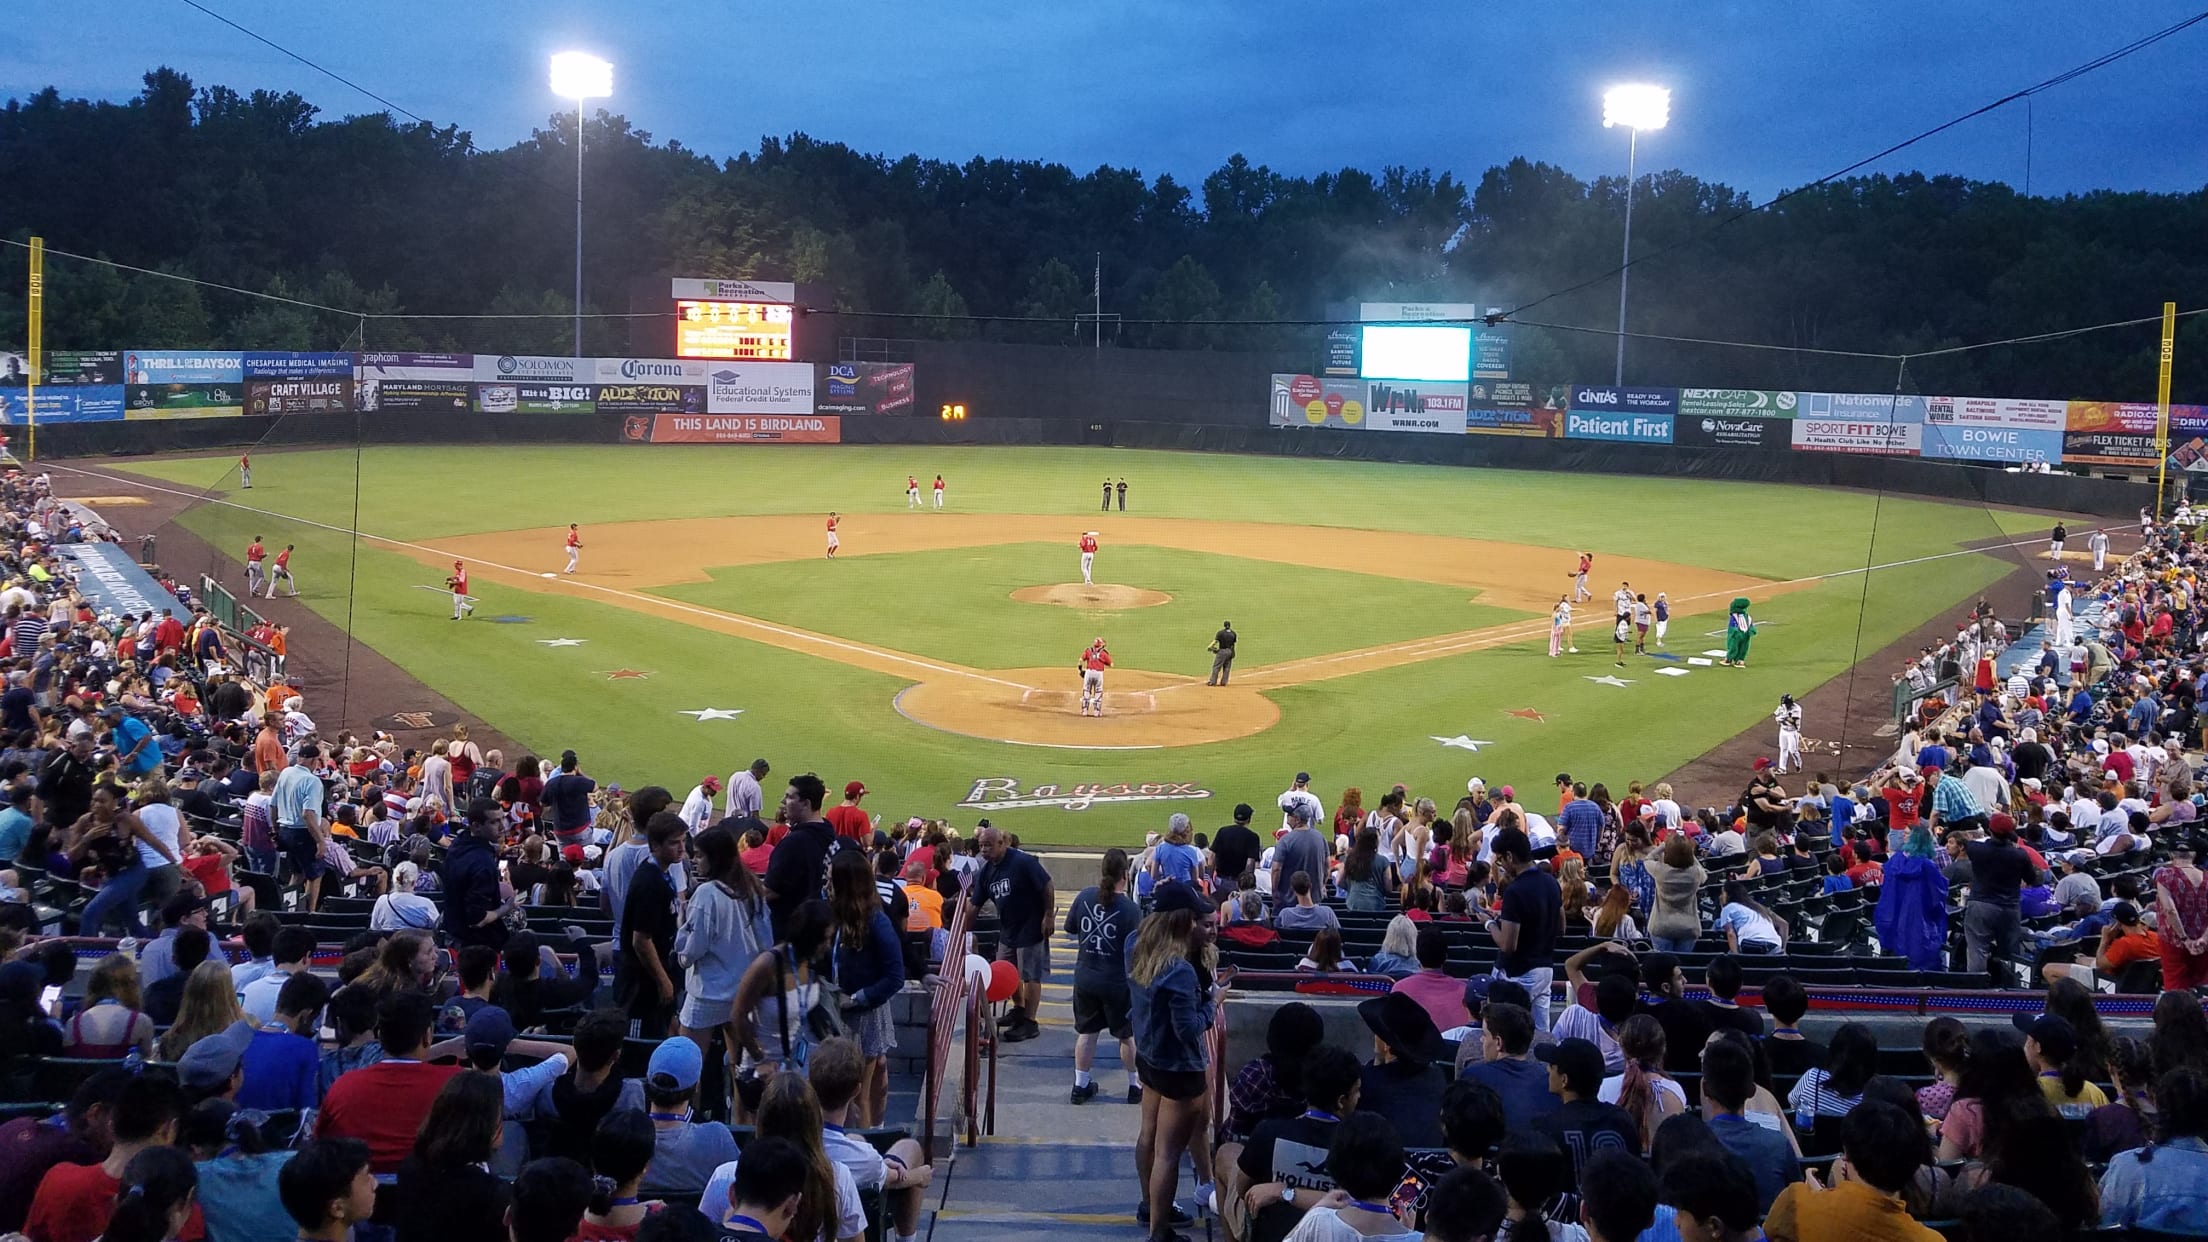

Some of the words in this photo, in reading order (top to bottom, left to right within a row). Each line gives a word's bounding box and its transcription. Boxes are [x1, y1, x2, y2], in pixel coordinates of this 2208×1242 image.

[718, 288, 765, 296] Recreation
[141, 358, 185, 369] THRILL
[194, 358, 241, 369] BAYSOX
[246, 359, 287, 367] CHESAPEAKE
[288, 359, 316, 367] MEDICAL
[318, 359, 349, 367] IMAGING
[362, 353, 400, 364] graphcom
[518, 360, 574, 370] SOLOMON
[621, 360, 683, 380] Corona
[254, 368, 277, 376] Radiology
[830, 366, 855, 376] DCA
[873, 366, 912, 383] TECHNOLOGY
[271, 383, 300, 396] CRAFT
[300, 383, 342, 395] VILLAGE
[521, 389, 537, 397] Hit
[540, 389, 548, 397] it
[548, 387, 591, 400] BIG!
[716, 386, 771, 395] Educational
[774, 386, 812, 397] Systems
[892, 384, 905, 392] FOR
[1683, 389, 1747, 400] NEXTCAR
[881, 396, 910, 410] BUSINESS
[1427, 398, 1448, 408] 103.1
[1449, 398, 1462, 409] FM
[1834, 395, 1913, 407] Nationwde
[818, 404, 867, 412] dcaimaging.com
[1834, 409, 1880, 418] Insurance
[1930, 404, 1954, 413] RENTAL
[1929, 413, 1954, 421] WORKS
[673, 418, 701, 430] THIS
[706, 418, 742, 430] LAND
[745, 418, 757, 430] IS
[760, 418, 826, 431] BIRDLAND.
[1392, 419, 1439, 428] WRNR.COM
[1569, 415, 1629, 435] Patient
[1633, 417, 1669, 437] First
[1715, 420, 1764, 432] NovaCare
[1806, 422, 1846, 434] SPORT
[1847, 424, 1875, 435] FIT
[1876, 425, 1907, 436] BOWIE
[1963, 430, 2019, 444] BOWIE
[2092, 435, 2112, 445] FLEX
[2114, 436, 2144, 446] TICKET
[1936, 444, 1981, 456] TOWN
[1986, 447, 2046, 460] CENTER
[964, 778, 1212, 811] Baysox
[1093, 903, 1105, 921] G
[1103, 923, 1117, 939] C
[1275, 1171, 1339, 1193] HOLLIST
